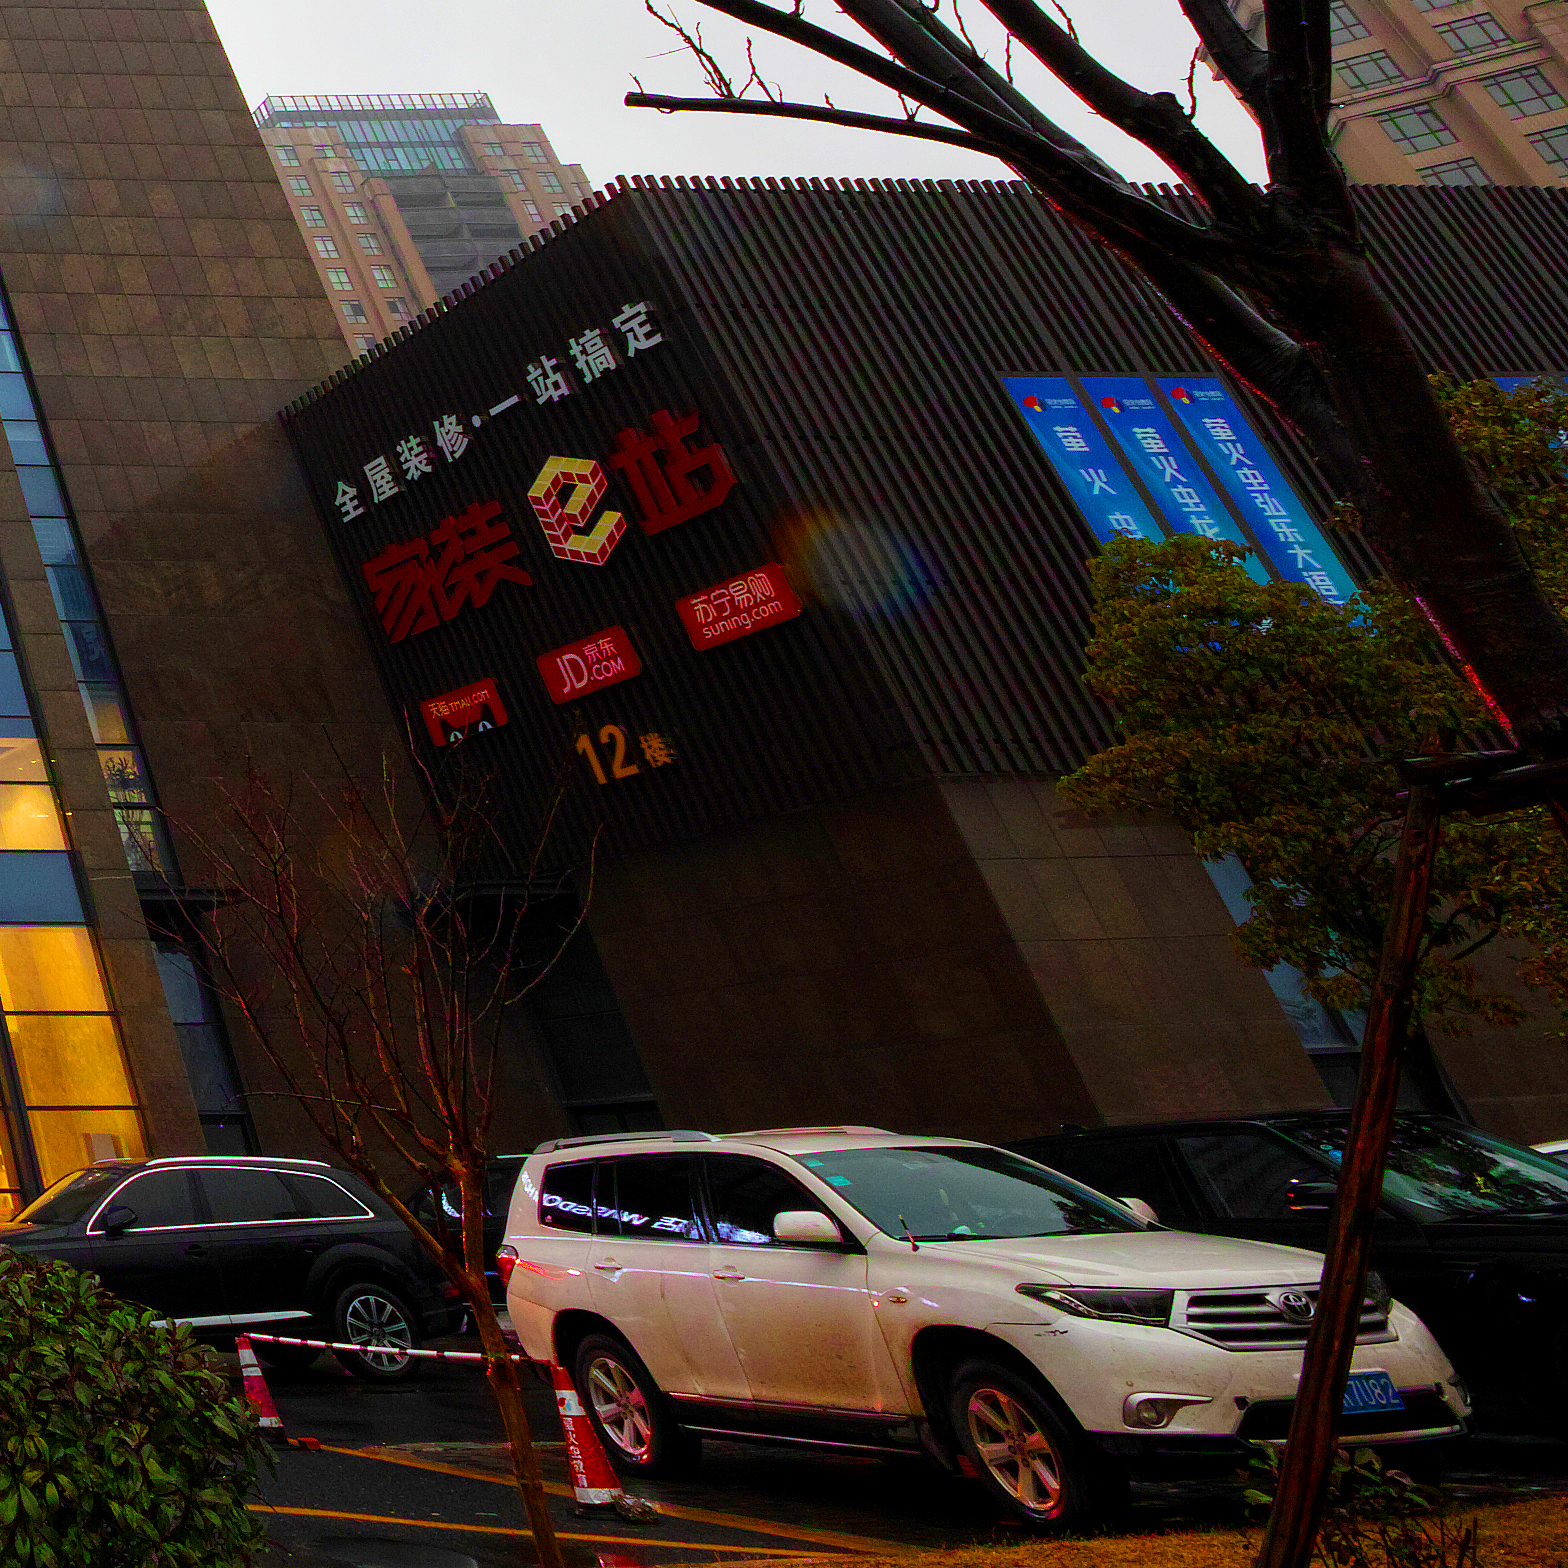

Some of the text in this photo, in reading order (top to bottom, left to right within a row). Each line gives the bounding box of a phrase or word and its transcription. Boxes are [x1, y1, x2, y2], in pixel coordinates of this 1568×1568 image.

[1202, 417, 1345, 605] 萤火虫弘乐大语
[689, 572, 777, 624] 苏宁易购
[701, 597, 783, 640] suning.com
[582, 637, 618, 663] 京东
[555, 651, 588, 694] JD
